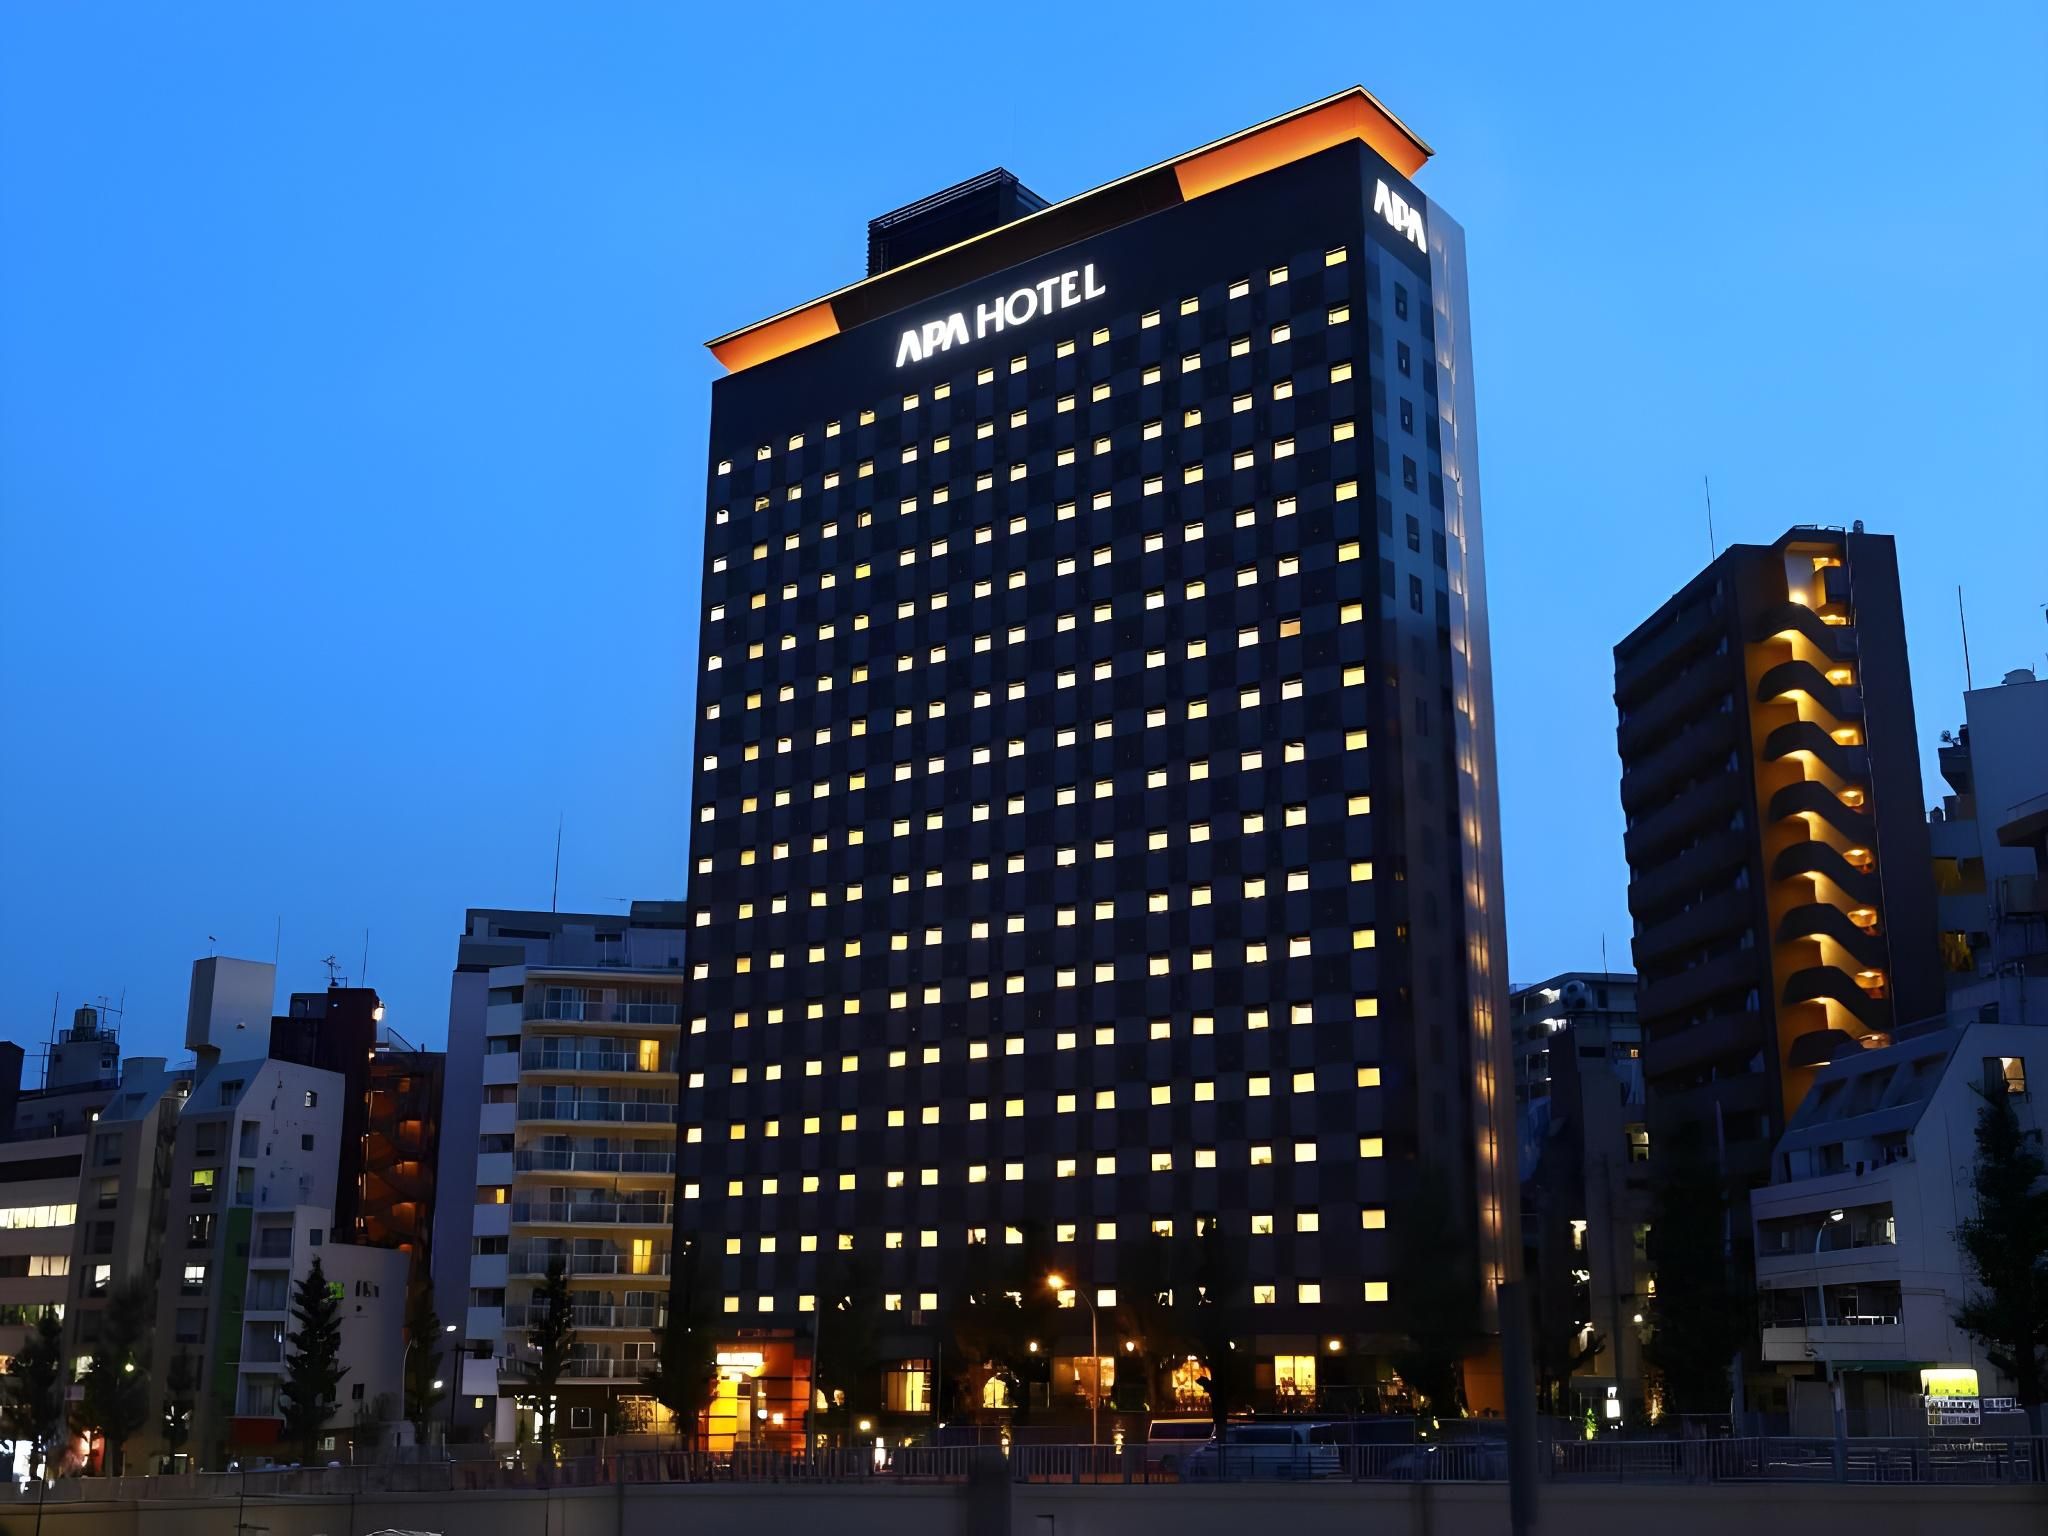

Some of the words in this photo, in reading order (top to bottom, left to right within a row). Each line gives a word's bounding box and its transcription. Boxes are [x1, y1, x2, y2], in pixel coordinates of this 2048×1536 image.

[1373, 178, 1427, 254] APA
[896, 312, 970, 368] APA
[976, 263, 1106, 339] HOTEL
